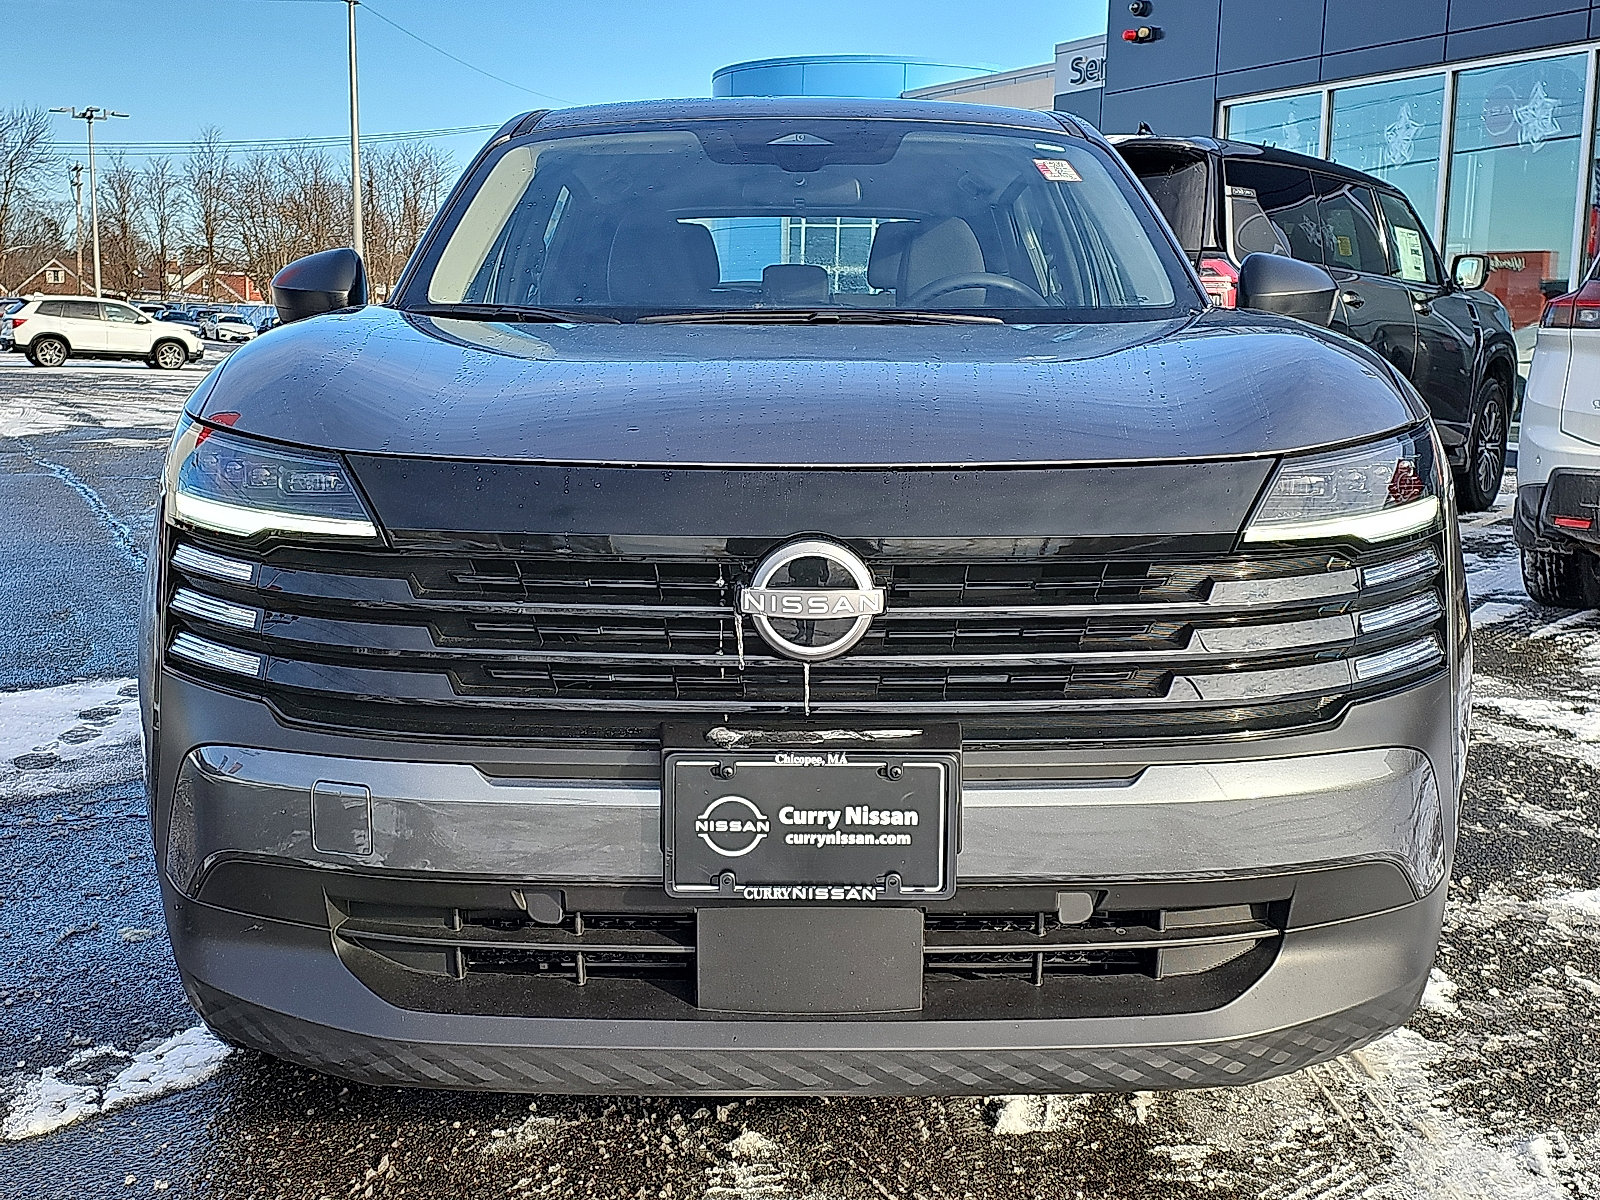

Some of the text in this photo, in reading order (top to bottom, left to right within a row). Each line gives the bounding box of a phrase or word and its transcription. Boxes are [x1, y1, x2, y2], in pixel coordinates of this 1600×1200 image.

[743, 594, 880, 614] NISSAN
[775, 753, 848, 766] Chicopee, MA
[695, 820, 770, 832] NISSAN
[778, 806, 919, 829] Curry Nissan
[785, 831, 912, 848] currynissan.com
